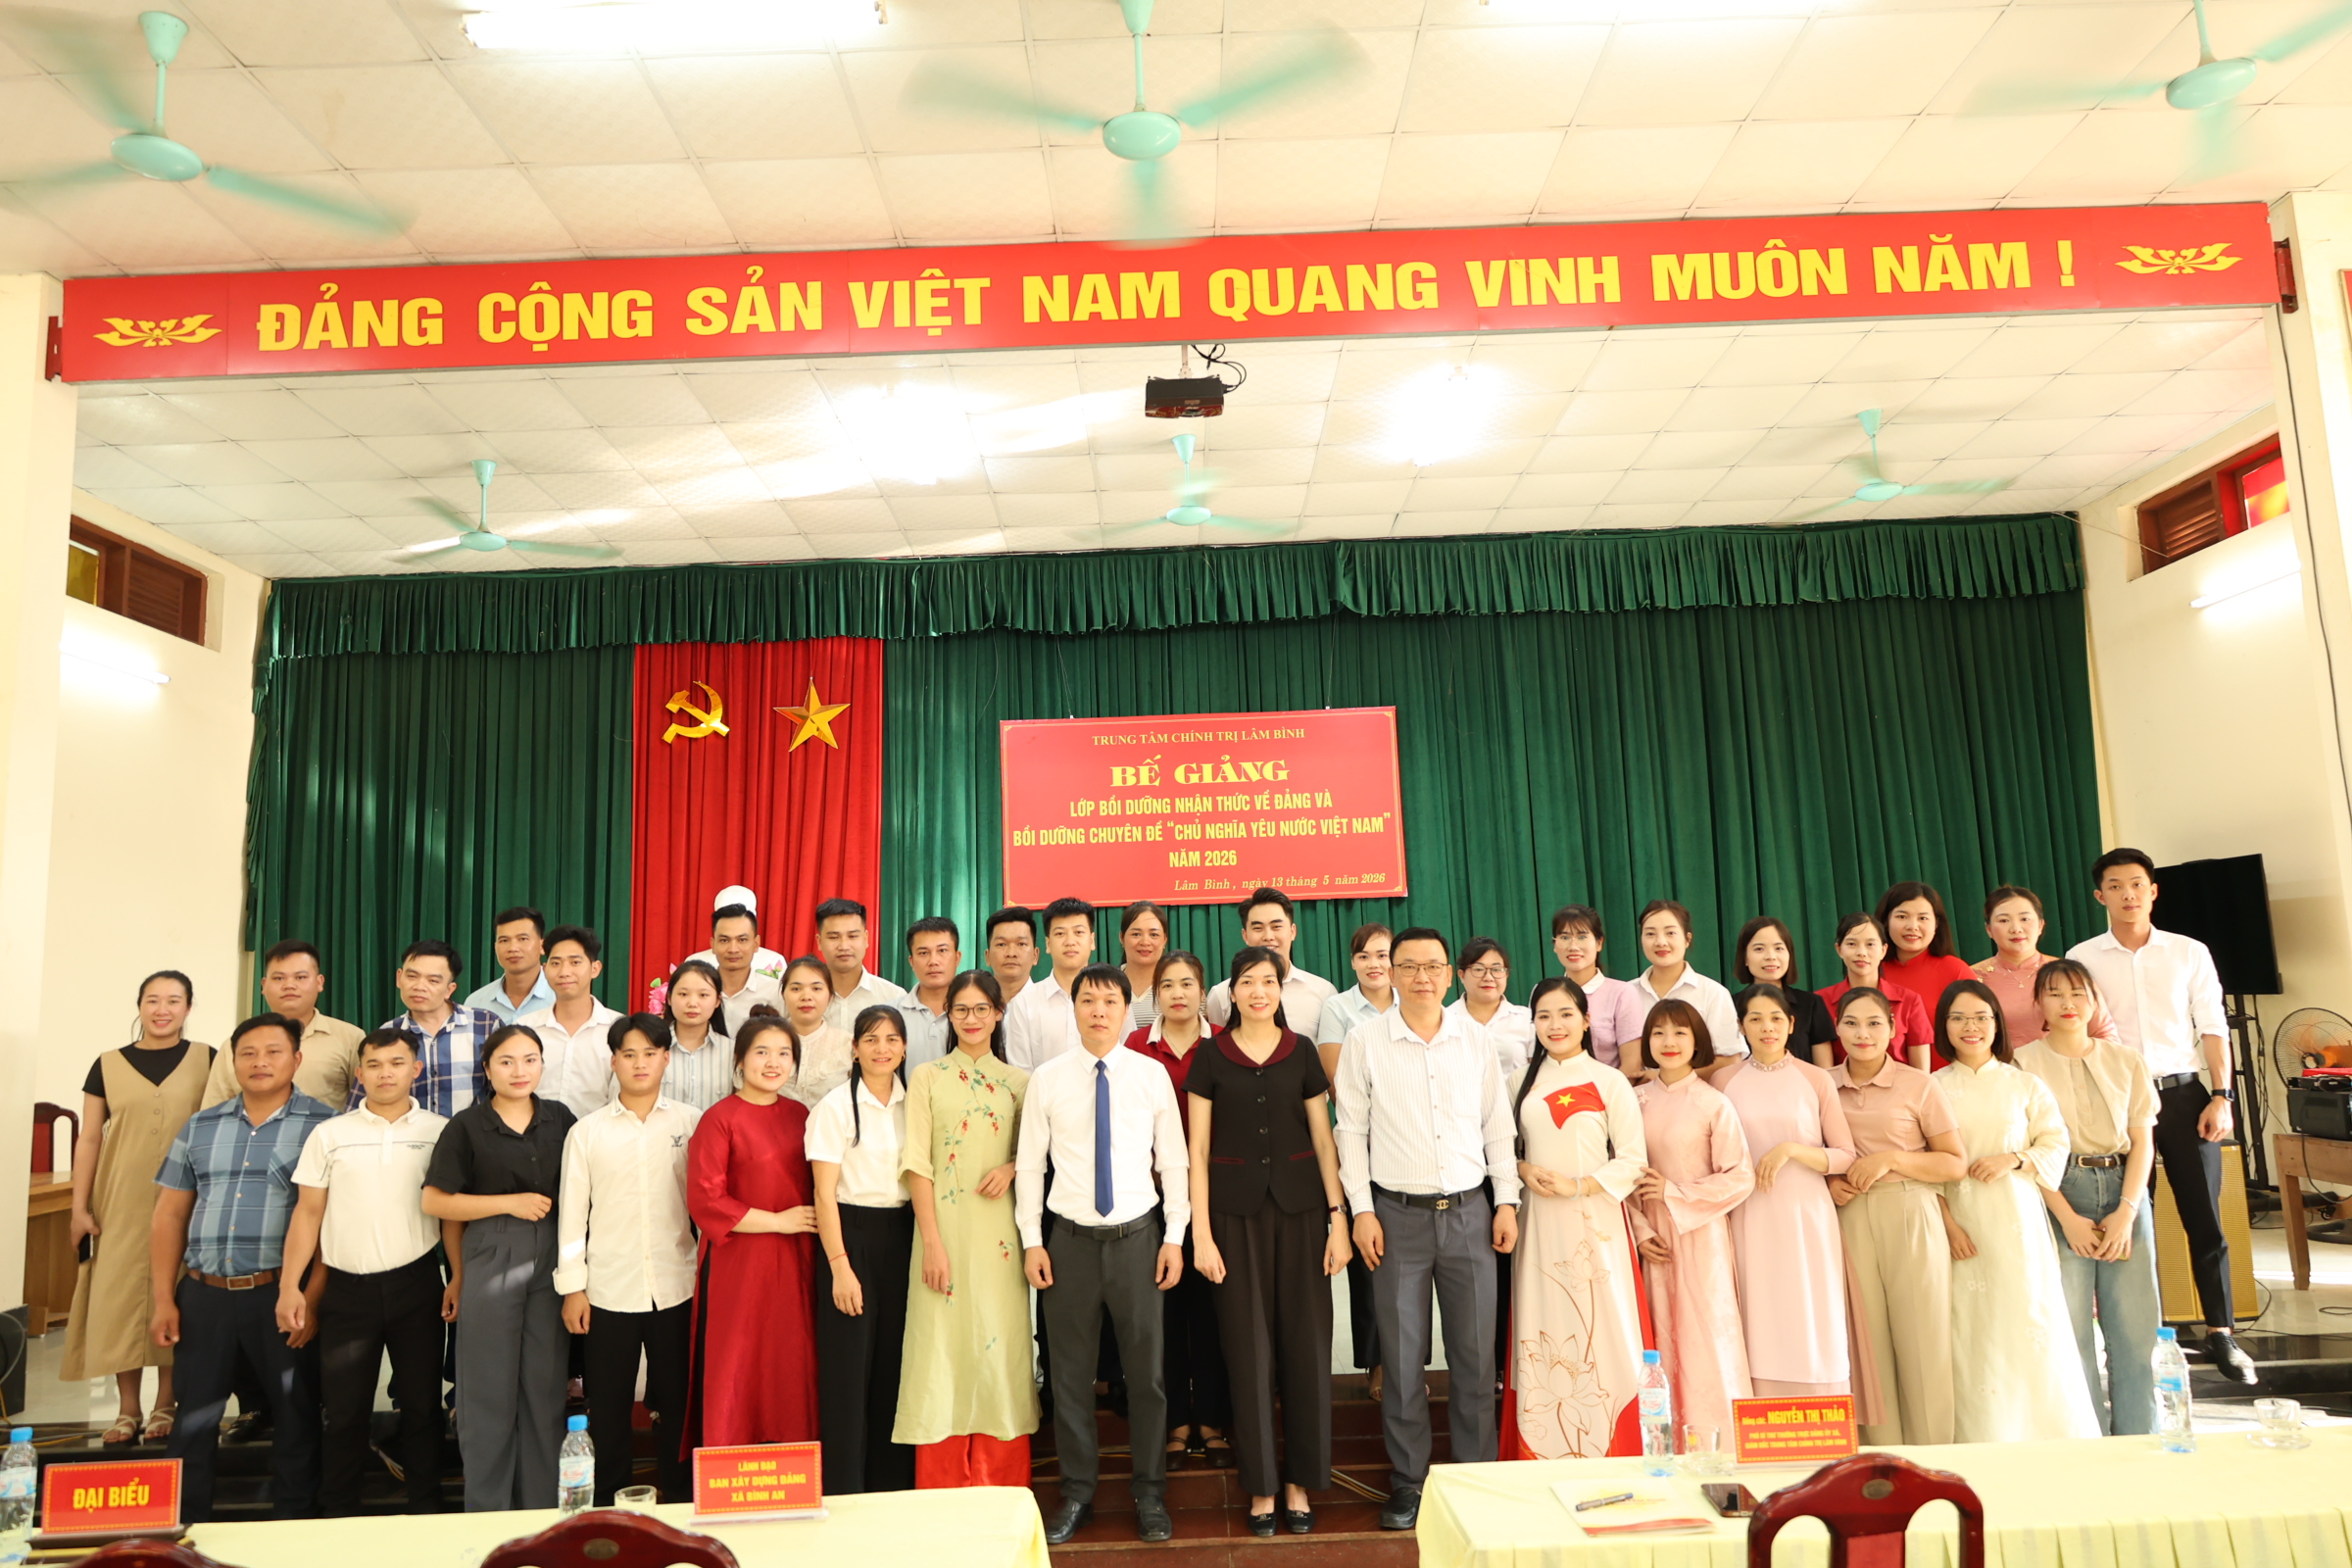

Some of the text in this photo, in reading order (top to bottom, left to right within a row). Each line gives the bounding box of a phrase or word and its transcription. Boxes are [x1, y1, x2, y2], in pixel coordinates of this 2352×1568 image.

[256, 282, 443, 352] ĐẢNG
[478, 281, 654, 352] CỘNG
[685, 265, 823, 336] SẢN
[848, 268, 991, 337] VIỆT
[1022, 270, 1181, 323] NAM
[1208, 261, 1440, 322] QUANG
[1464, 256, 1622, 308] VINH
[1650, 238, 1848, 302] MUÔN
[1872, 233, 2032, 294] NĂM
[1092, 727, 1305, 746] TRUNG TÂM CHÍNH TRỊ LÂM BÌNH
[1109, 754, 1291, 787] BẾ GIẢNG
[1070, 788, 1333, 817] LỚP BỒI DƯỠNG NHẬN THỨC VỀ ĐẢNG VÀ
[1012, 824, 1036, 847] BỒI
[1039, 825, 1086, 846] DƯỠNG
[1089, 822, 1143, 844] CHUYÊN
[1145, 819, 1163, 842] ĐỀ
[1204, 819, 1248, 840] NGHĨA
[1250, 818, 1276, 838] YÊU
[1279, 816, 1317, 837] NƯỚC
[1319, 814, 1348, 838] VIỆT
[1168, 848, 1238, 868] NĂM 2026
[1174, 879, 1199, 891] Lâm
[1271, 876, 1284, 888] 13
[1286, 875, 1318, 888] tháng
[1322, 874, 1330, 886] 5
[1334, 874, 1359, 885] năm
[1360, 872, 1386, 884] 2026
[1767, 1405, 1804, 1424] NGUYỄN
[1805, 1409, 1821, 1426] THỊ
[1821, 1404, 1845, 1422] THẢO
[73, 1477, 150, 1513] ĐẠI BIỂU
